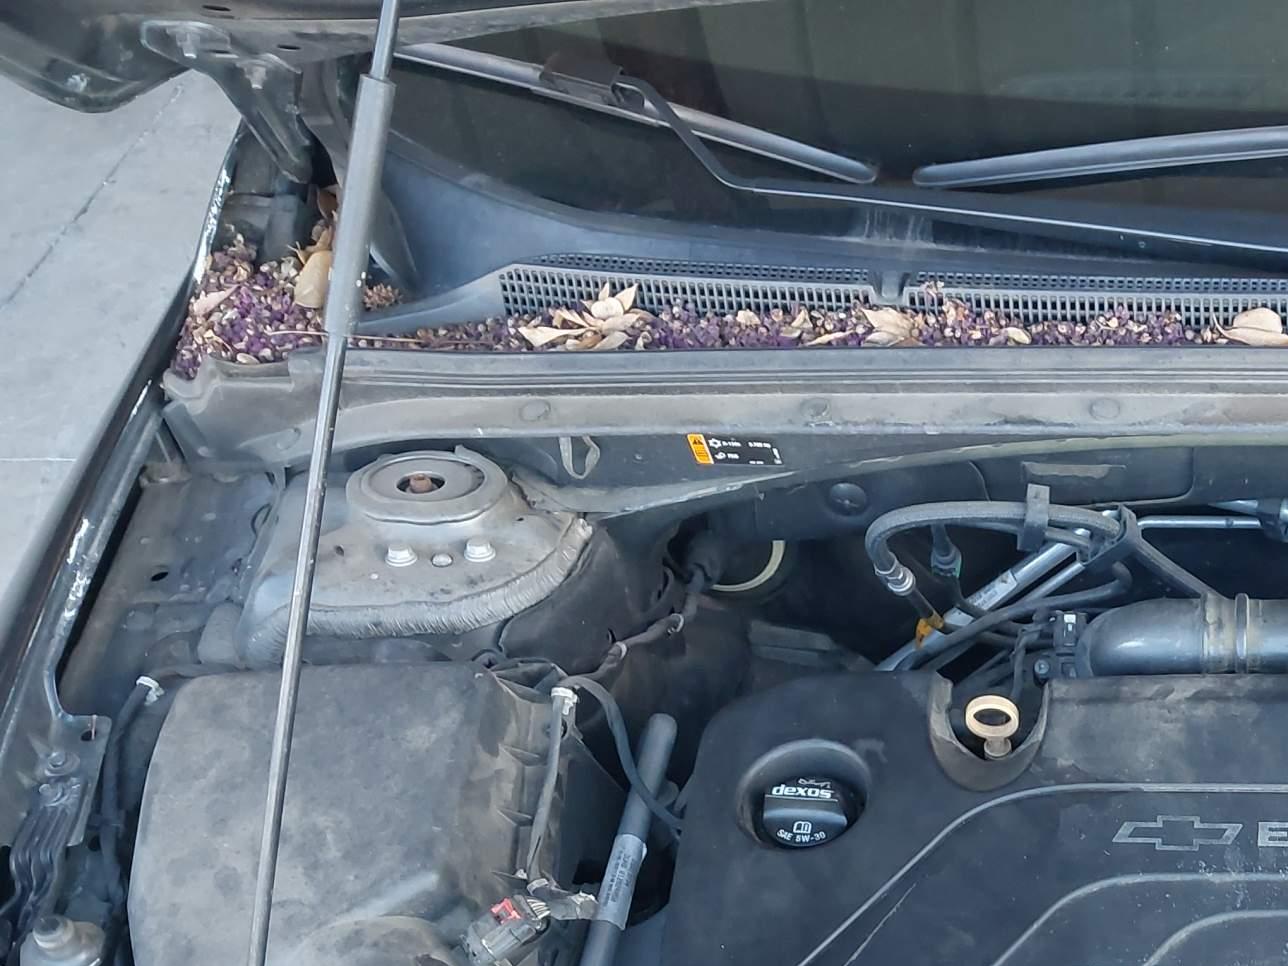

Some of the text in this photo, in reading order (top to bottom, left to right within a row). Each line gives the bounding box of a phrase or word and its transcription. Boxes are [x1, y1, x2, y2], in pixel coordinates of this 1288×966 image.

[771, 784, 835, 799] dexos
[776, 829, 826, 843] SAE 5W-30
